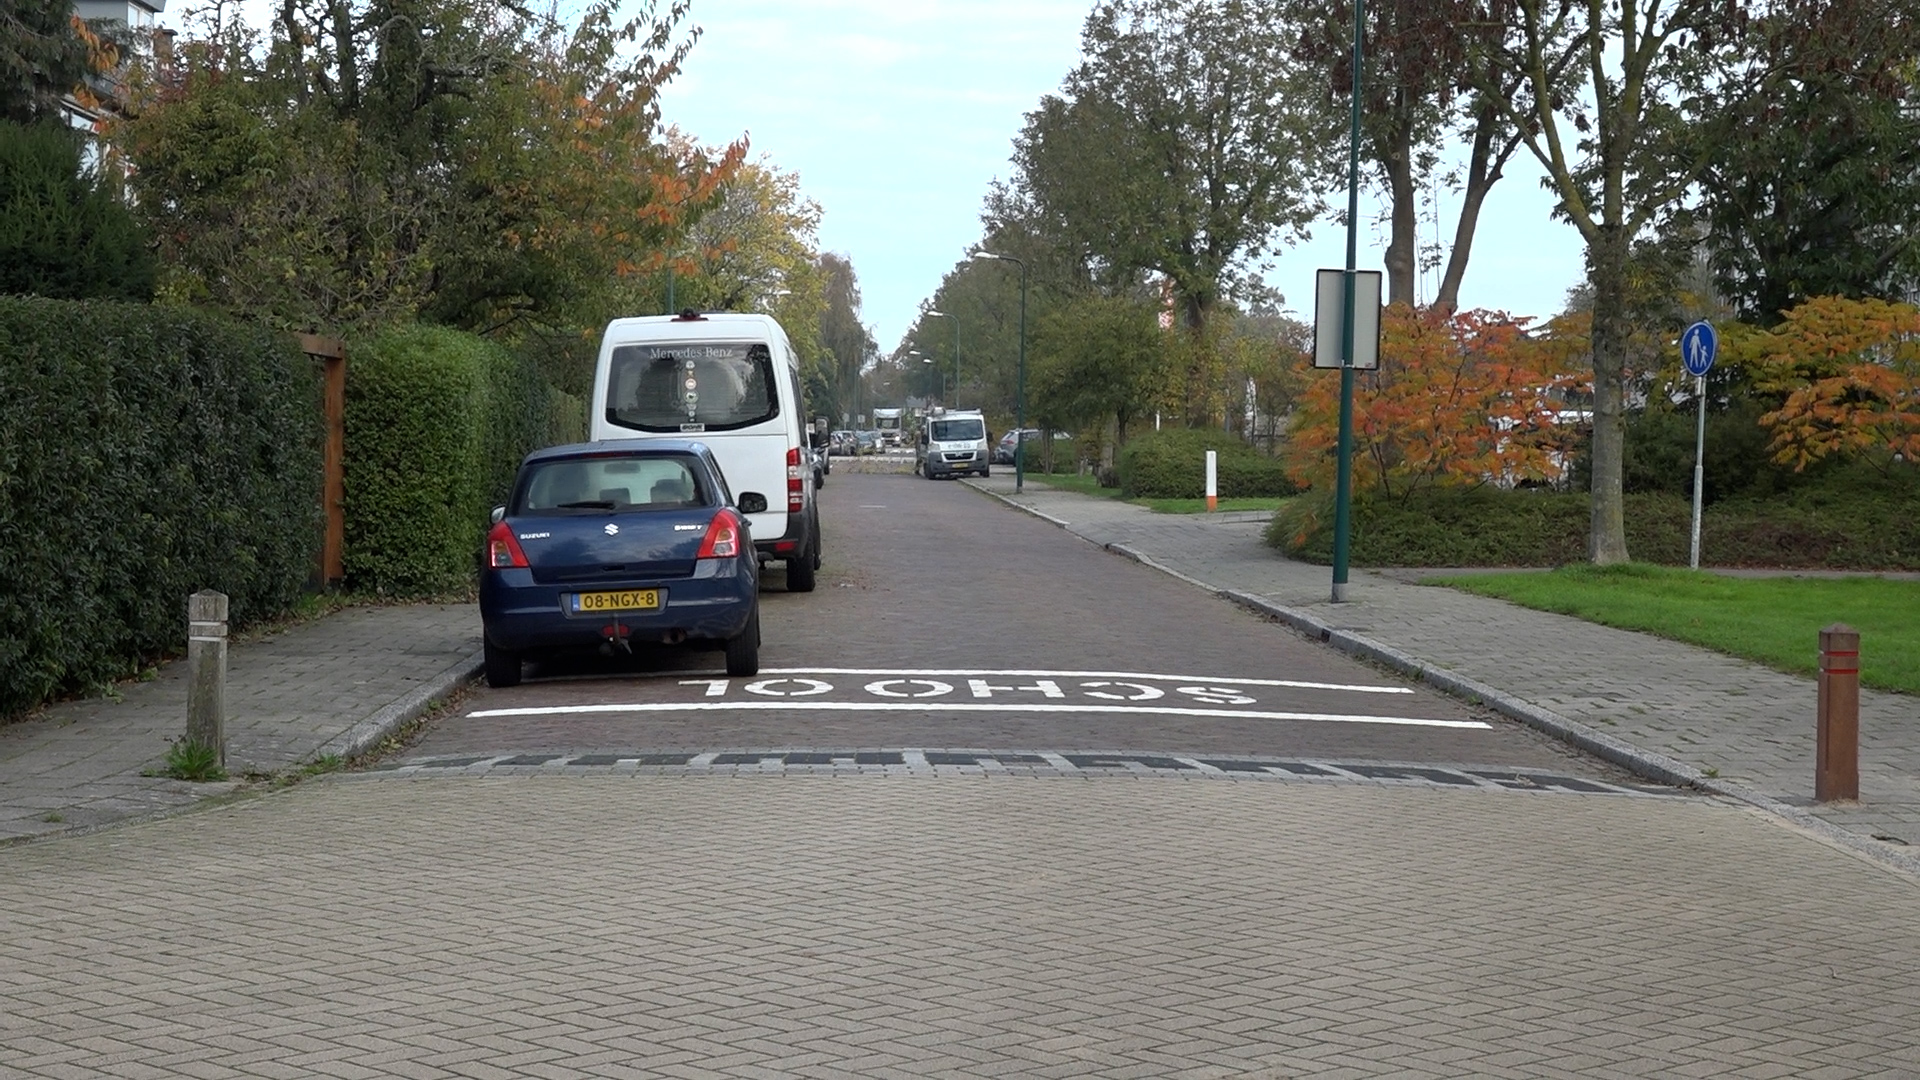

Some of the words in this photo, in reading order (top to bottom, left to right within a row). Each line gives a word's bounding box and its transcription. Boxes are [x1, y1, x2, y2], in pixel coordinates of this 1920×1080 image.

[520, 532, 550, 540] SUZUKI
[583, 592, 655, 609] 08-NGX-8
[678, 678, 1258, 705] SCHOOL
